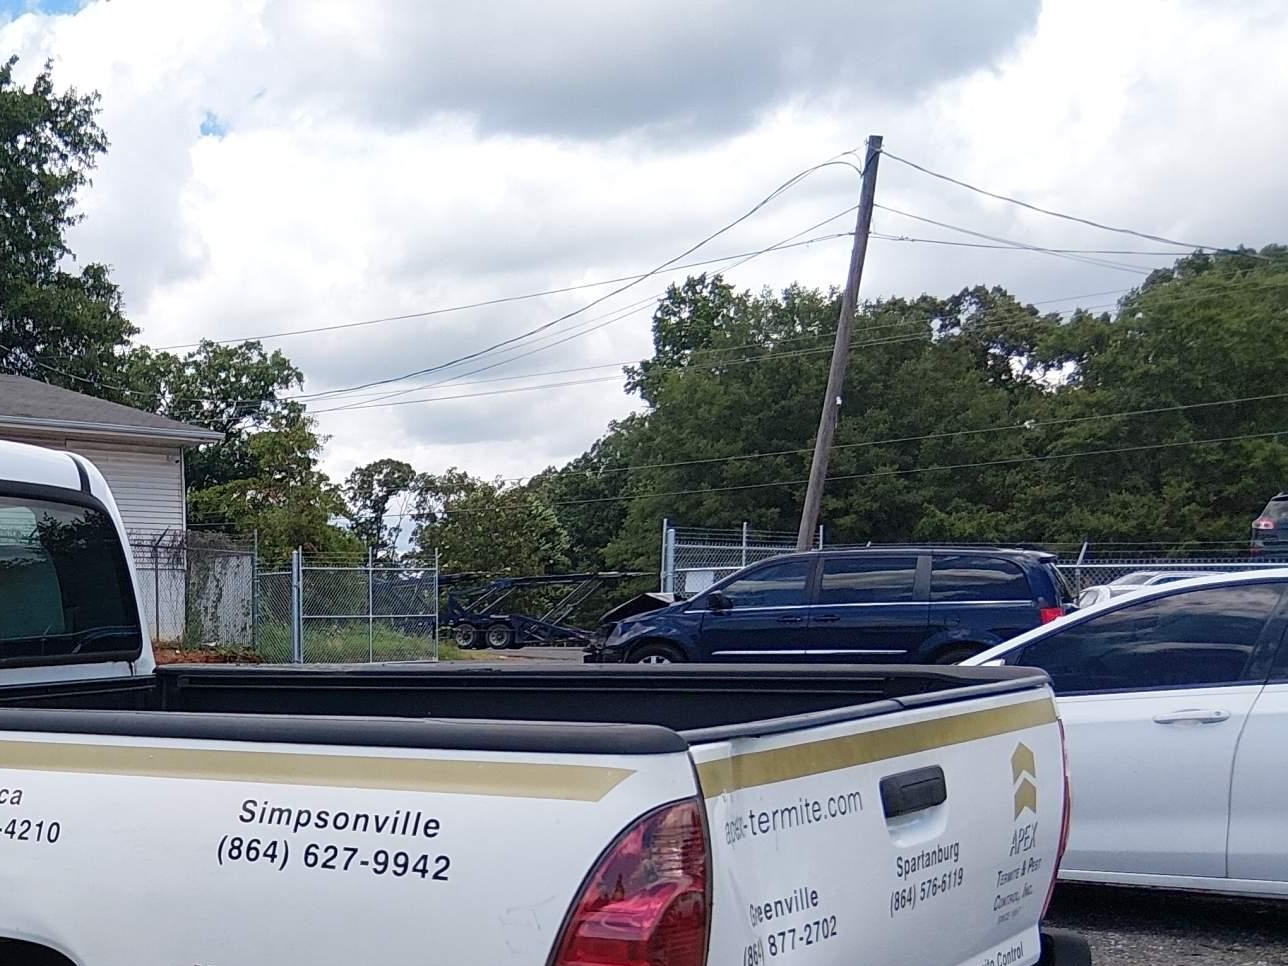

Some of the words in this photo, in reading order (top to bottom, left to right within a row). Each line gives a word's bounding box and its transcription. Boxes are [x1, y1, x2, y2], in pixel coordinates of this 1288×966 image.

[239, 800, 441, 839] Simpsonville
[1009, 821, 1038, 856] APEX
[217, 835, 289, 871] (864)
[303, 843, 451, 881] 627-9942
[896, 841, 960, 880] Spartanburg
[749, 887, 818, 927] Greenville
[890, 884, 917, 918] (864)
[920, 867, 964, 901] 576-6119
[768, 915, 837, 956] 877-2702
